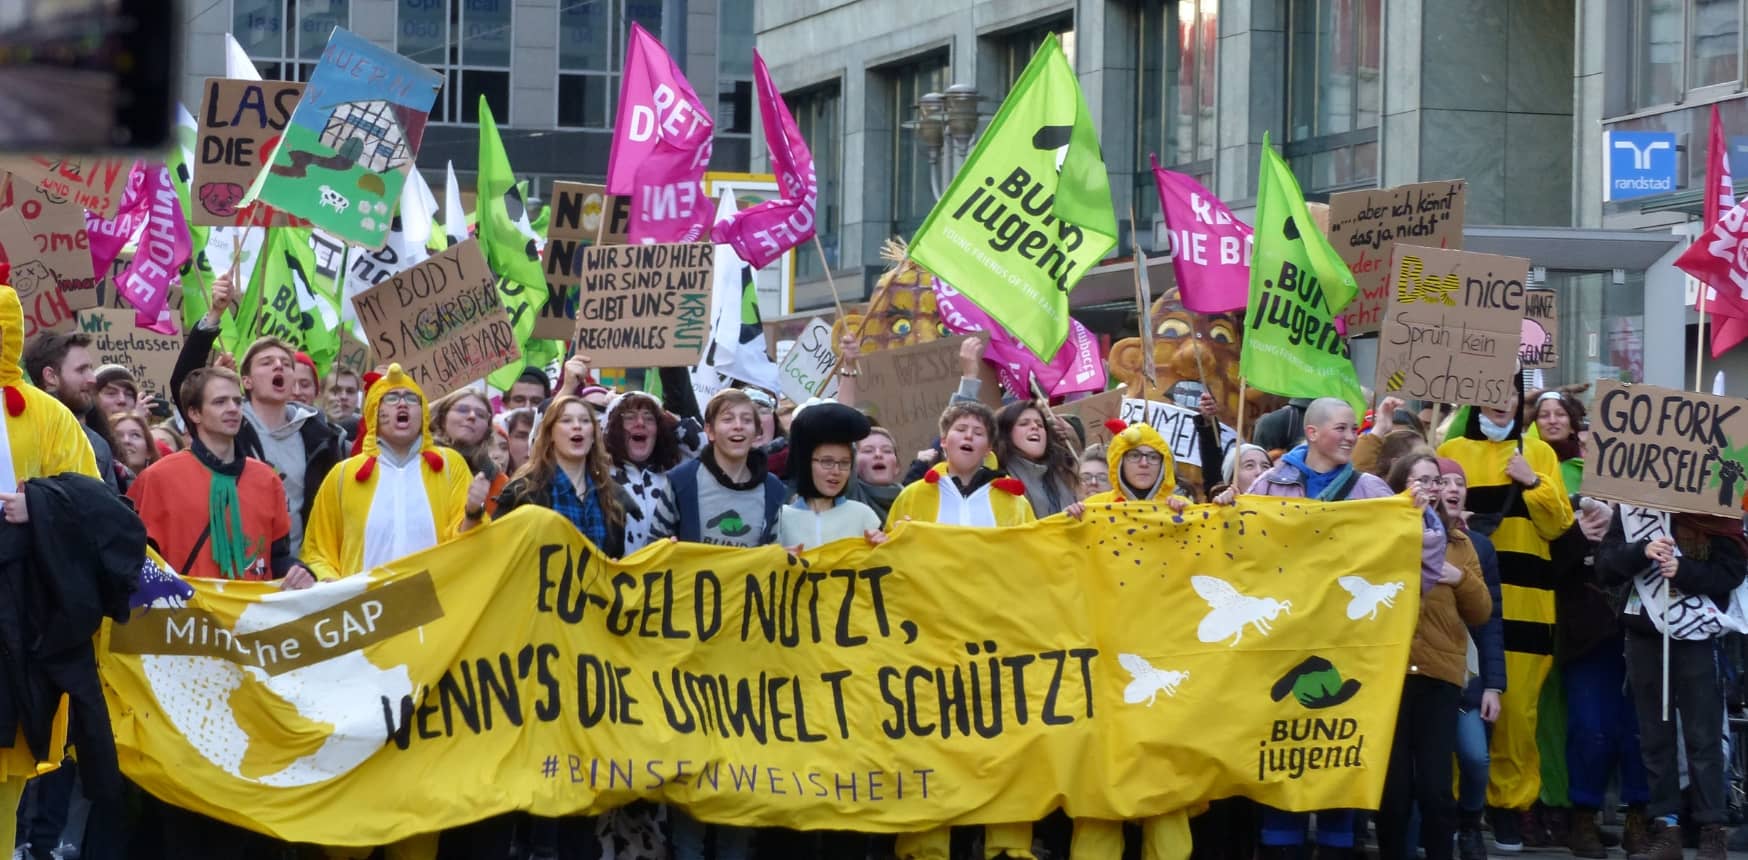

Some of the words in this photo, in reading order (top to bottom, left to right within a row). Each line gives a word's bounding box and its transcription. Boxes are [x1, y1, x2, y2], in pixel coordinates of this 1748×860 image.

[202, 135, 255, 167] DIE
[1614, 175, 1671, 191] randstad
[1391, 190, 1413, 218] ich
[1350, 229, 1372, 248] das
[1373, 221, 1394, 250] ja
[587, 248, 618, 272] WIR
[621, 245, 668, 270] SIND
[669, 244, 714, 269] HIER
[358, 292, 388, 326] MY
[393, 247, 465, 309] BODY
[586, 273, 617, 292] WIR
[622, 272, 662, 292] SIND
[1397, 255, 1461, 307] Bee
[1465, 271, 1524, 311] nice
[372, 331, 397, 361] IS
[400, 319, 421, 357] A
[415, 278, 499, 342] GARDEN
[583, 295, 628, 322] GIBT
[631, 292, 677, 318] UNS
[673, 292, 709, 355] KRAUT
[97, 333, 181, 351] überlassen
[101, 351, 133, 365] euch
[432, 319, 514, 384] GRAVEYARD
[577, 326, 669, 351] REGIONALES
[1460, 321, 1497, 355] kein
[1600, 389, 1653, 436] GO
[1656, 396, 1741, 449] FORK
[1592, 431, 1717, 495] YOURSELF
[537, 543, 722, 643] EU-GELD
[741, 552, 919, 648] NÜTZT,
[313, 599, 384, 649] GAP
[381, 643, 560, 751] WENN'S
[577, 654, 643, 728] DIE
[652, 666, 853, 745] UMWELT
[877, 641, 1099, 740] SCHÜTZT
[1271, 717, 1360, 743] BUND
[541, 754, 935, 802] #BINSENWEISHEIT
[1258, 734, 1365, 784] jugend
